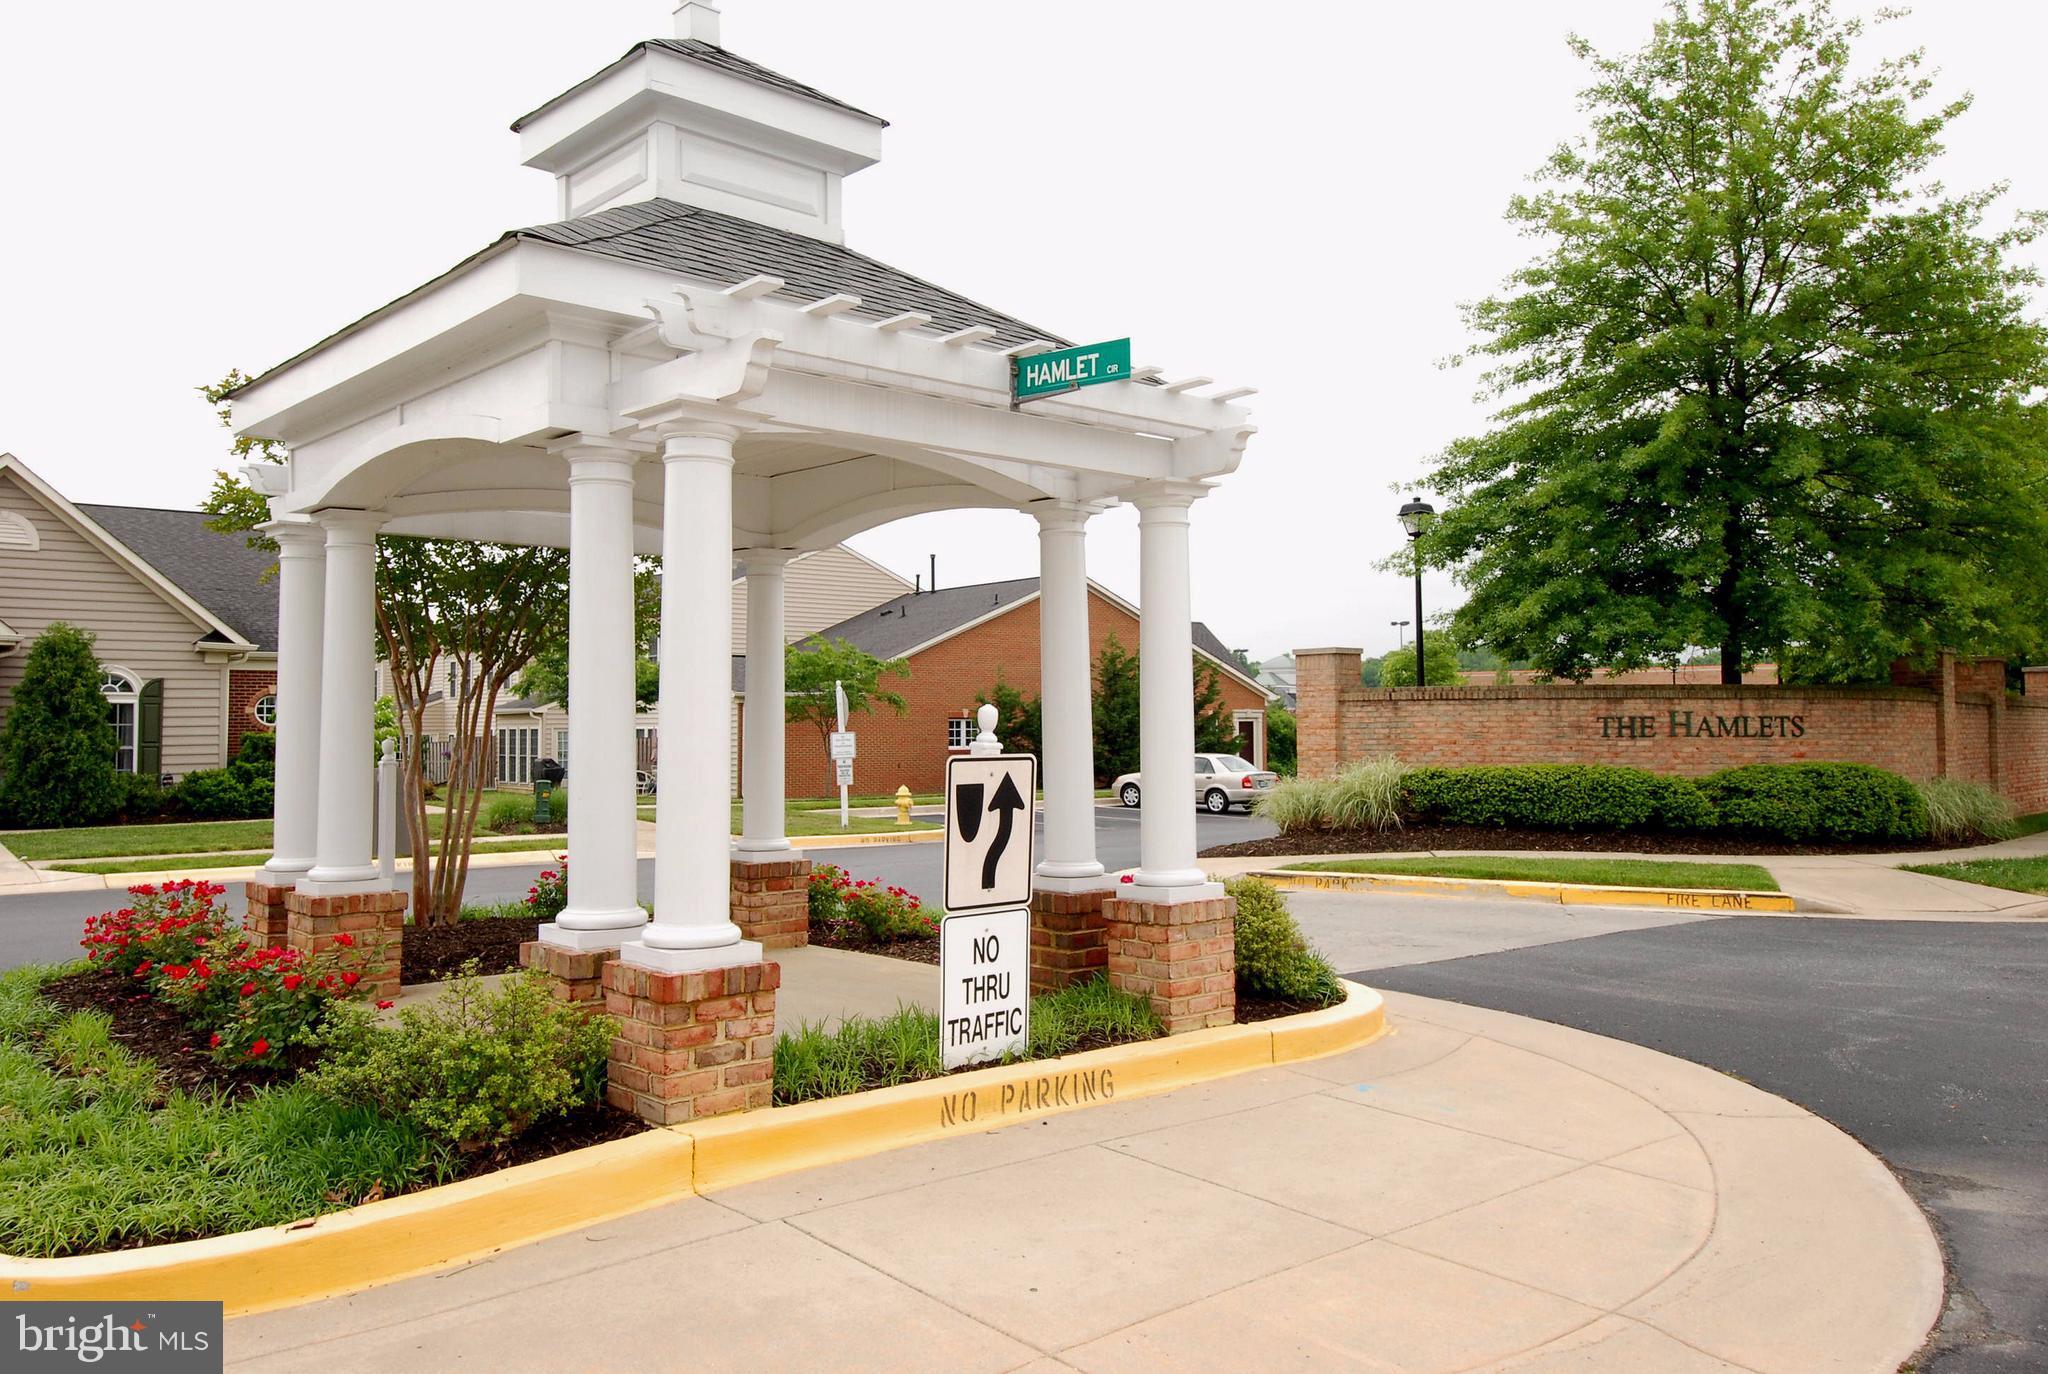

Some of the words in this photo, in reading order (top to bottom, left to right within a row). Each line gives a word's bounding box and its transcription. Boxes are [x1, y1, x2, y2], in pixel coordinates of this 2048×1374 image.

[1026, 352, 1100, 388] HAMLET
[1106, 363, 1120, 375] CIR
[1597, 715, 1657, 739] THE
[1666, 892, 1701, 908] FIRE
[1711, 894, 1753, 910] LANE
[972, 934, 1001, 965] NO
[962, 971, 1011, 1005] THRU
[947, 1007, 1023, 1047] TRAFFIC
[940, 1091, 977, 1128] NO
[1000, 1068, 1115, 1115] PARKING
